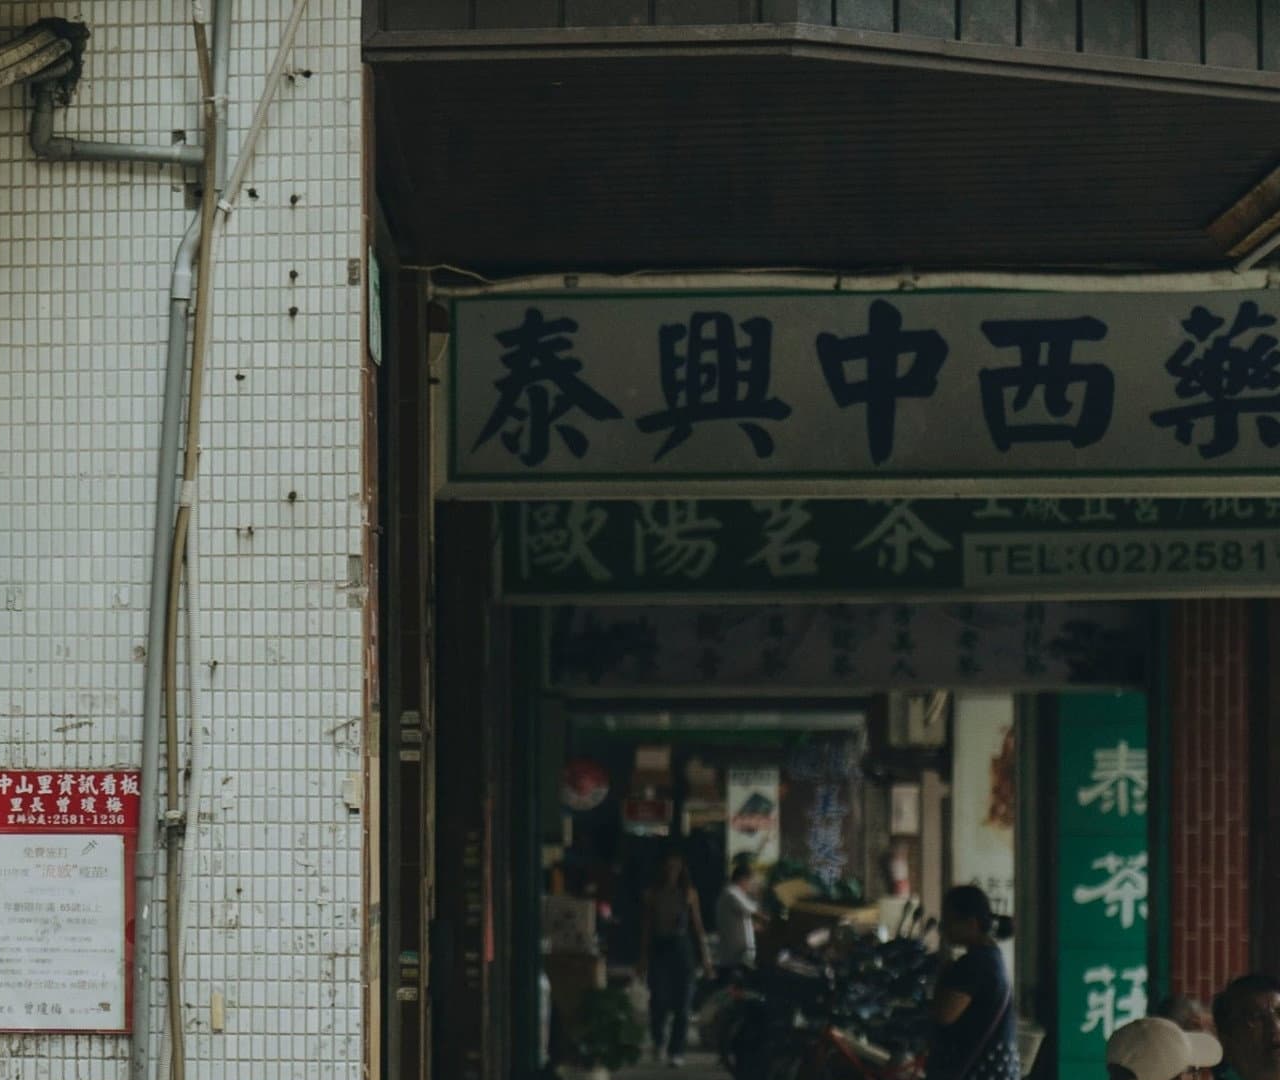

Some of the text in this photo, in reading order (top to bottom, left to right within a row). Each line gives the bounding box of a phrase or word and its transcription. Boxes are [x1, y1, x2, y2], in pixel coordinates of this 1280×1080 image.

[470, 297, 1280, 464] 泰興中西藥
[974, 539, 1280, 576] TEL:(02)2581
[10, 797, 45, 812] 里長
[1073, 739, 1148, 1041] 泰茶莊
